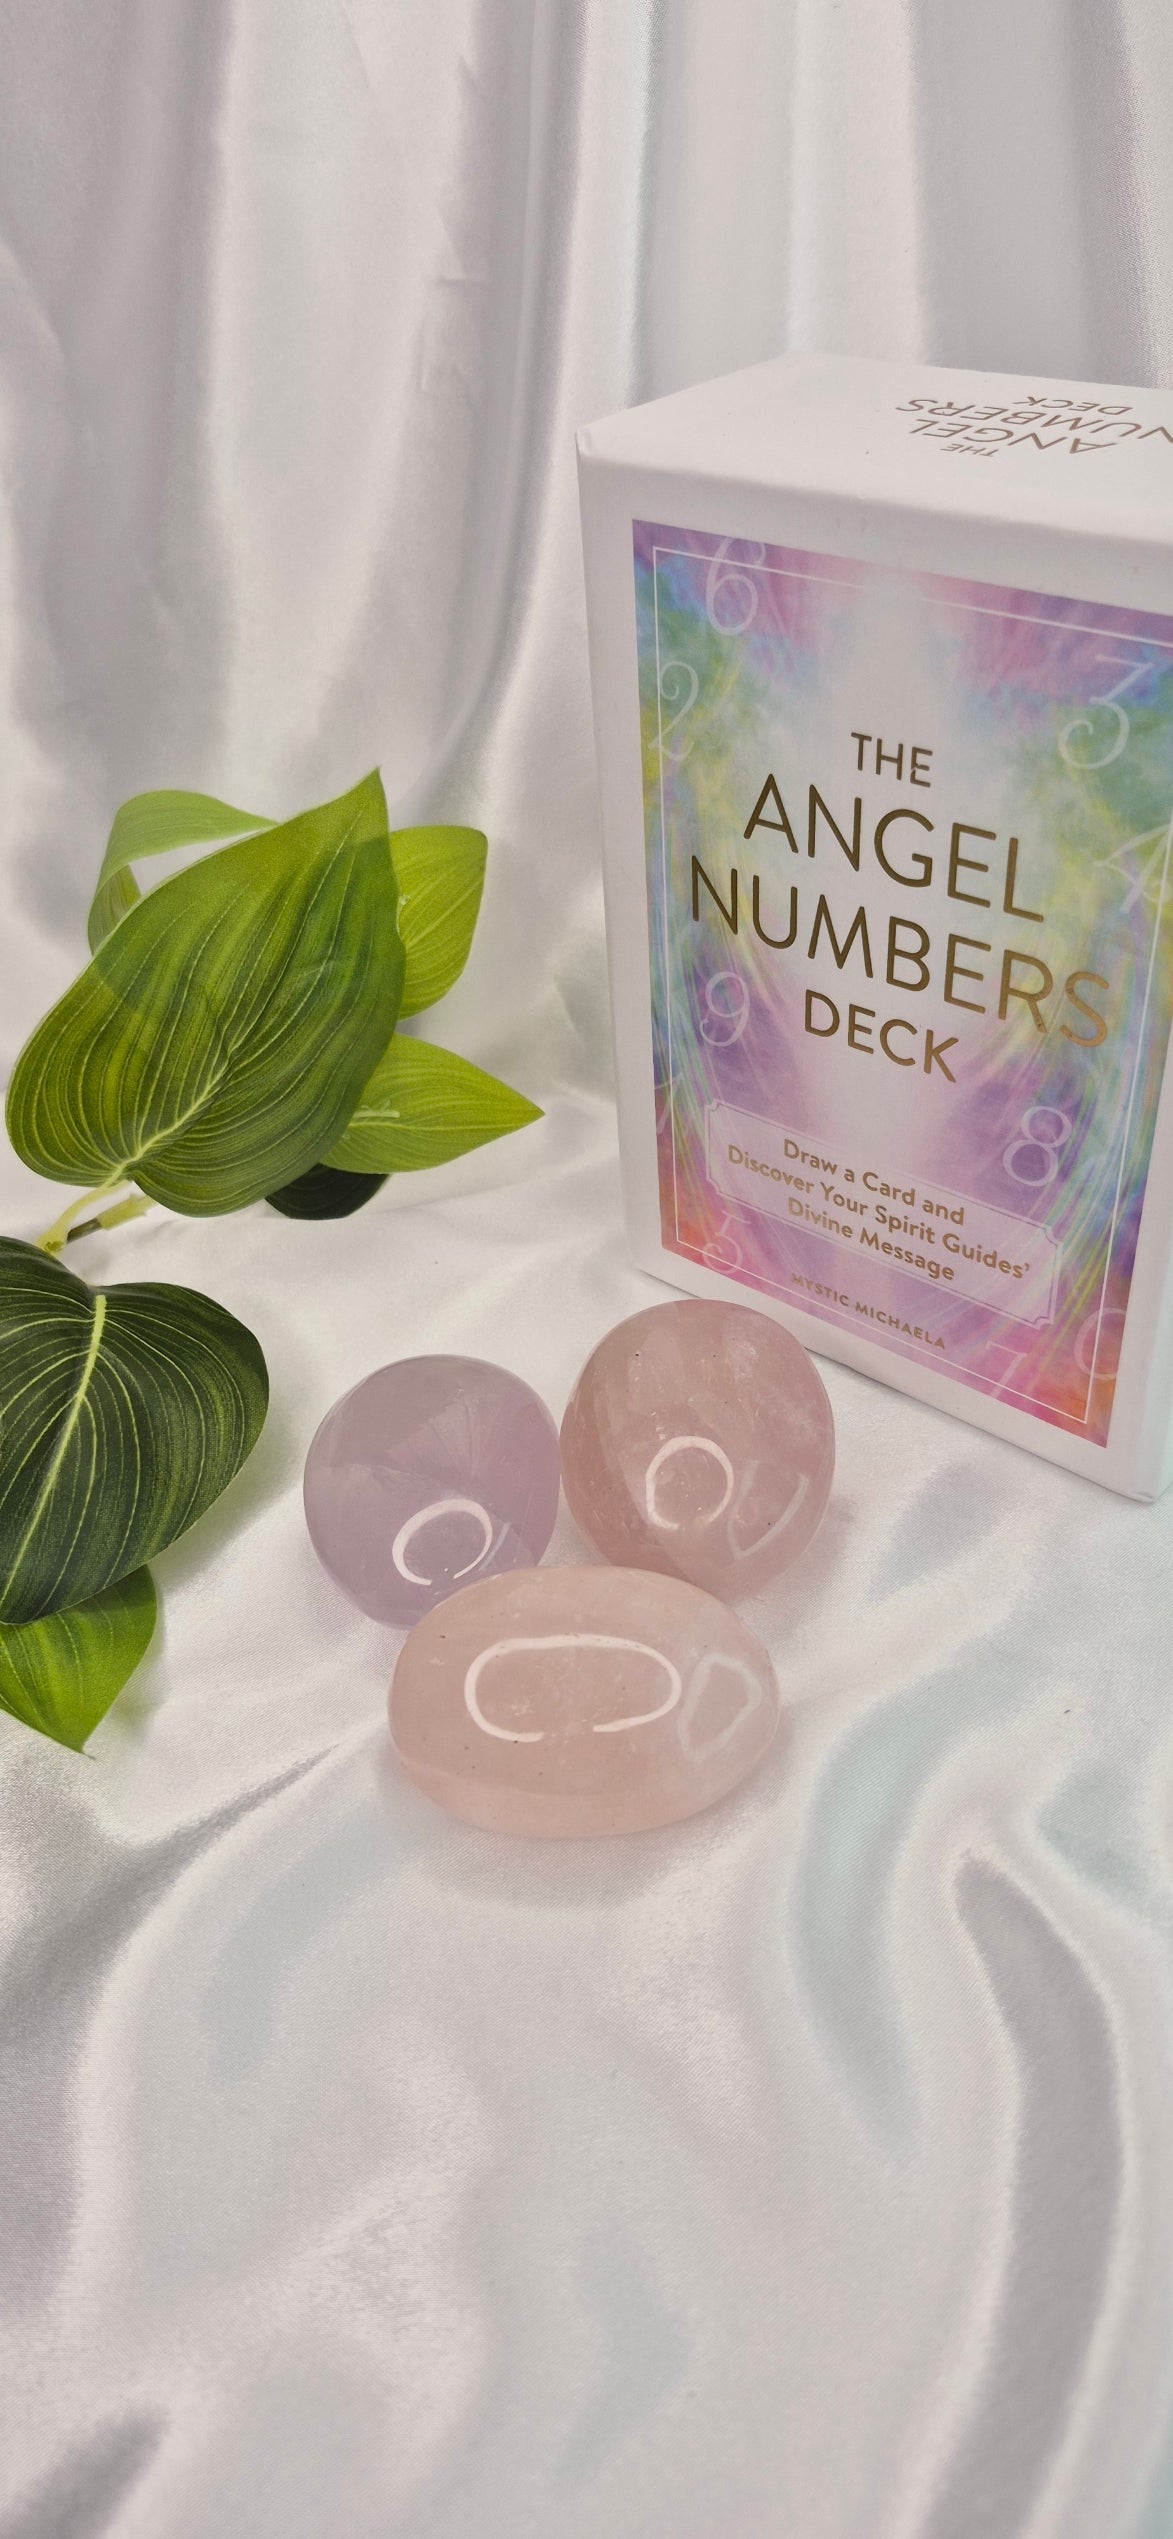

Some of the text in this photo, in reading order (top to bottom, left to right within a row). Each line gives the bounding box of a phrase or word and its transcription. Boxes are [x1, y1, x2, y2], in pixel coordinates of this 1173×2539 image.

[908, 418, 1118, 454] ANGEL
[1012, 396, 1133, 415] DECK
[940, 443, 1000, 457] THE
[706, 535, 766, 636] 6
[648, 661, 699, 758] 2
[1057, 654, 1154, 769] 3
[851, 732, 933, 787] THE
[743, 774, 1044, 923] ANGEL
[692, 855, 1110, 1048] NUMBERS
[699, 970, 751, 1048] 9
[804, 989, 959, 1083] DECK
[784, 1139, 965, 1226] Draw a Card and
[1002, 1105, 1072, 1187] 8
[728, 1144, 814, 1194] Discover
[820, 1181, 868, 1215] Your
[875, 1205, 935, 1244] Spirit
[788, 1197, 955, 1280] Divine Message
[789, 1273, 946, 1349] MYSTIC MICHAELA
